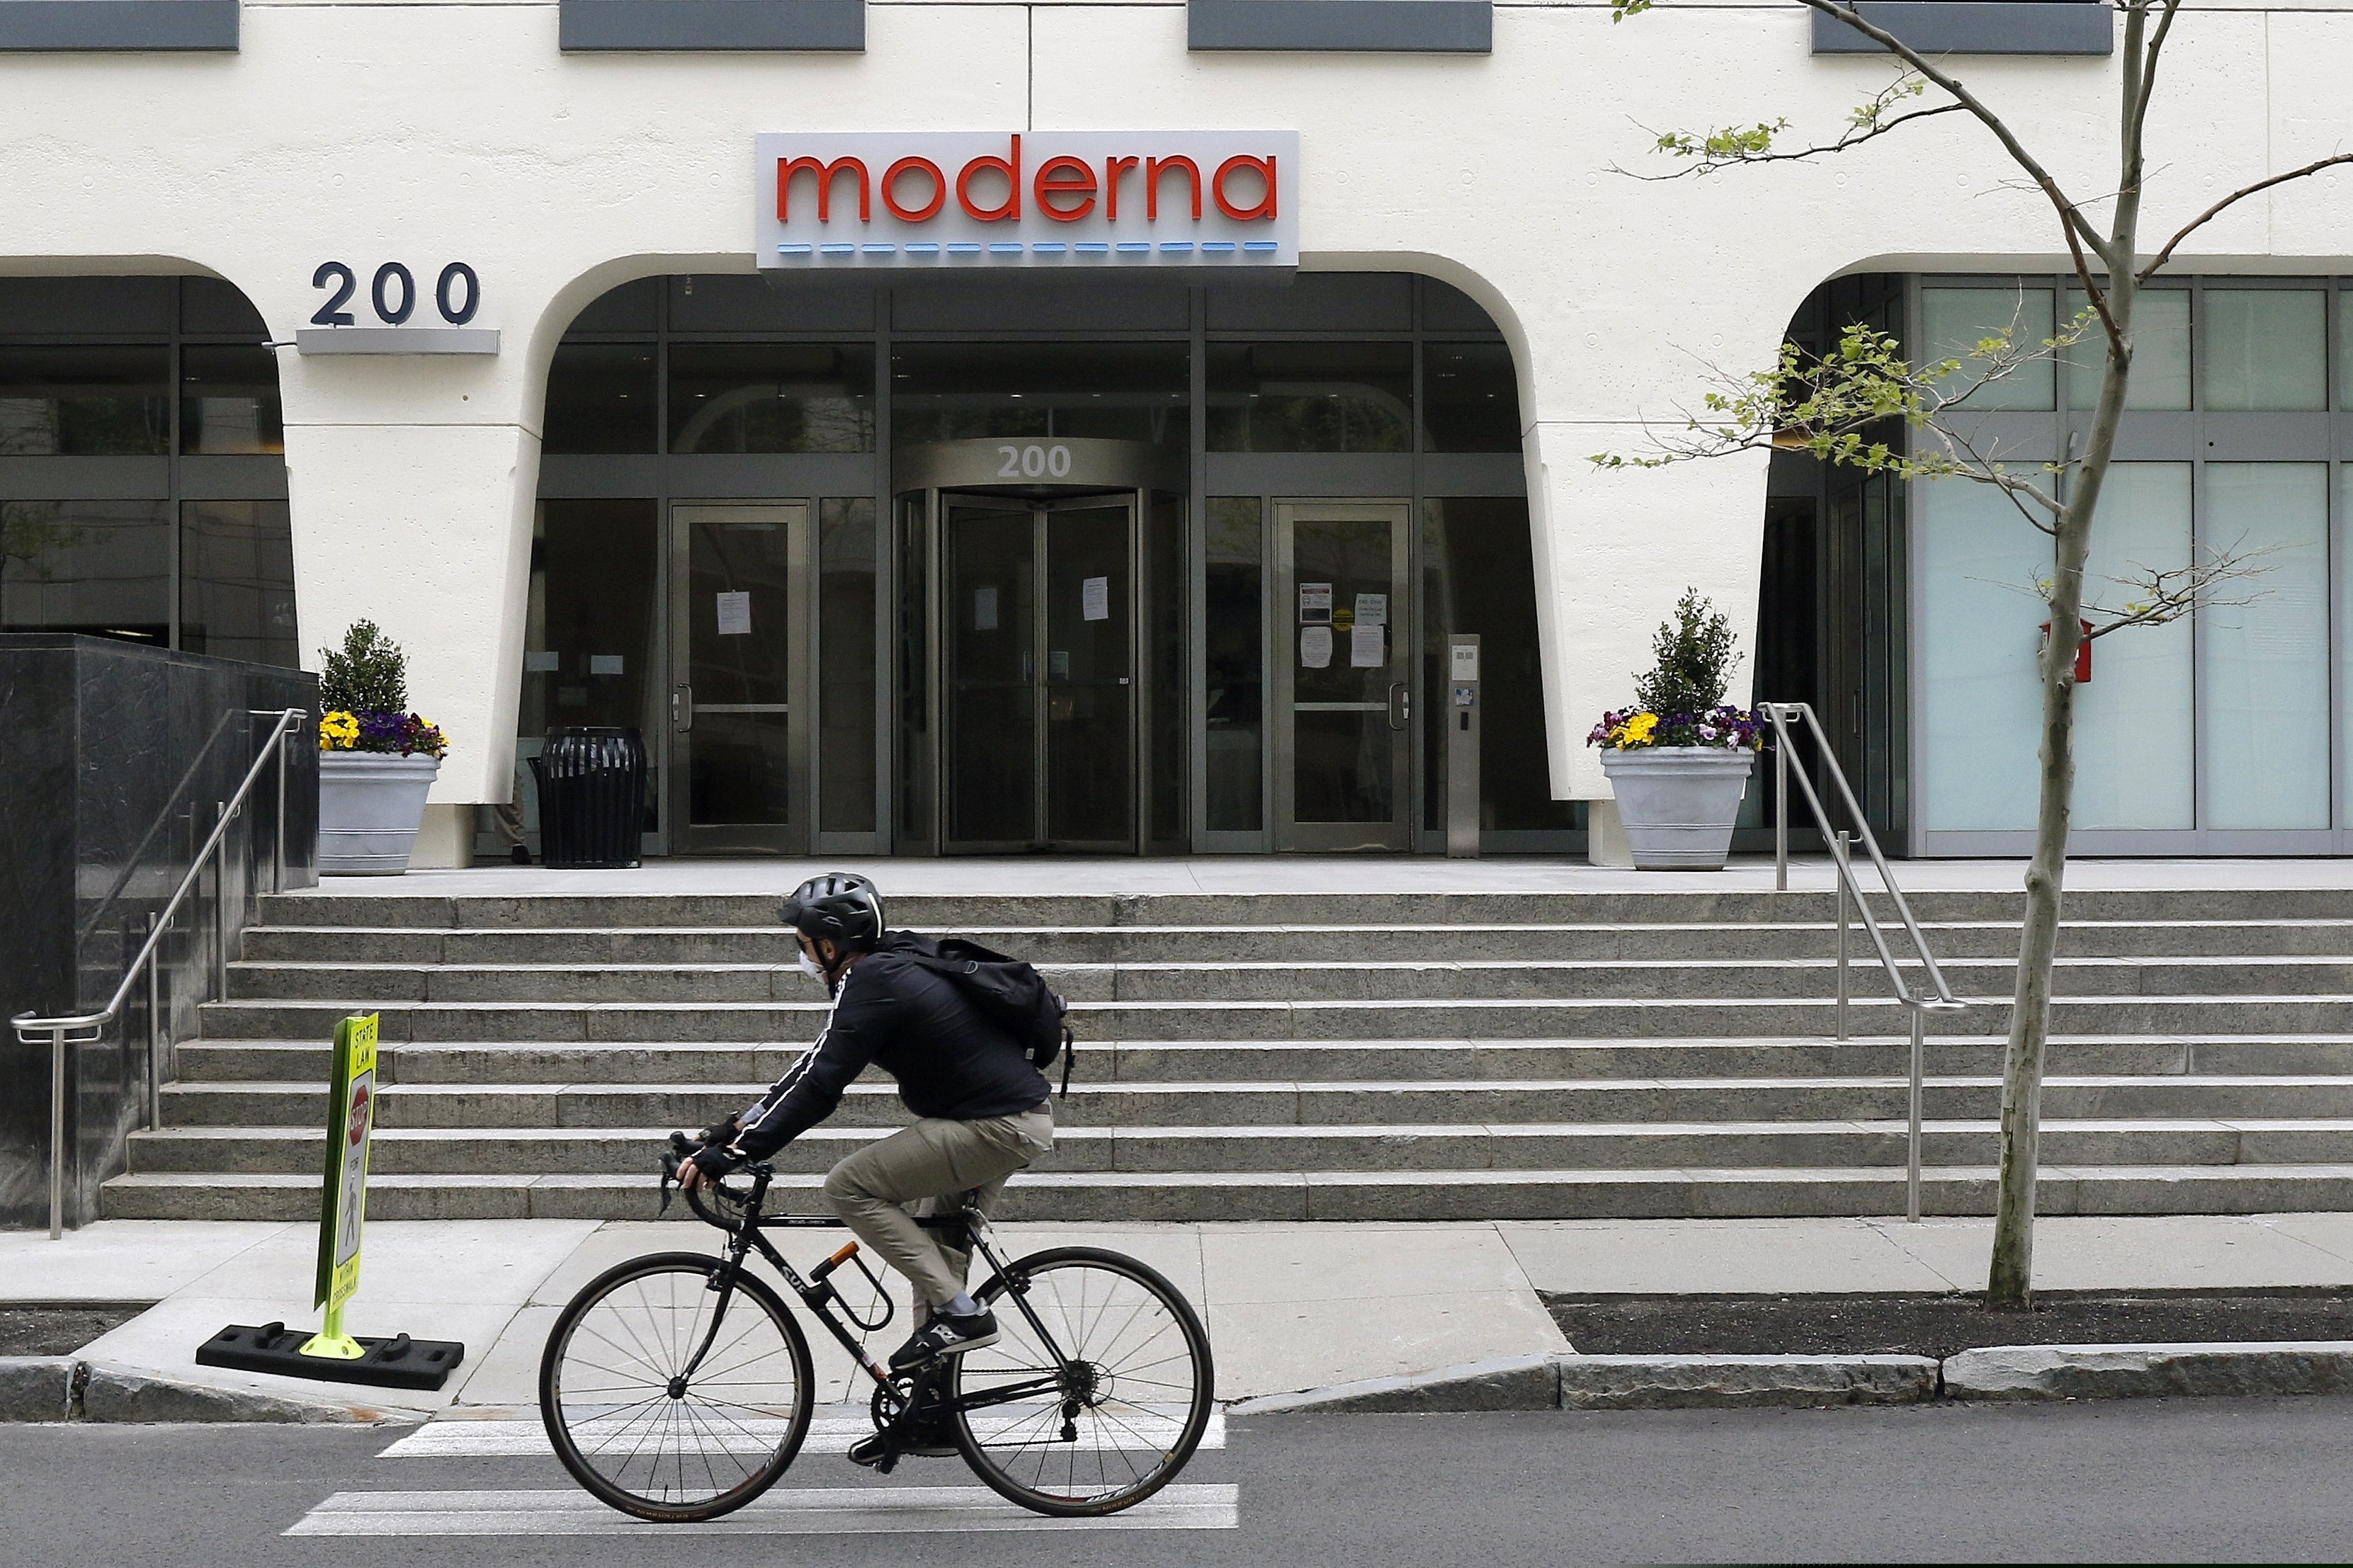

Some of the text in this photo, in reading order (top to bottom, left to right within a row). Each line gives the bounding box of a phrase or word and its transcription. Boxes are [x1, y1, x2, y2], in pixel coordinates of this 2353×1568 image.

[776, 133, 1278, 222] moderna
[310, 261, 480, 326] 200
[997, 445, 1072, 477] 200
[355, 1023, 374, 1049] STATE
[356, 1047, 370, 1070] LAW
[350, 1101, 368, 1131] STOP
